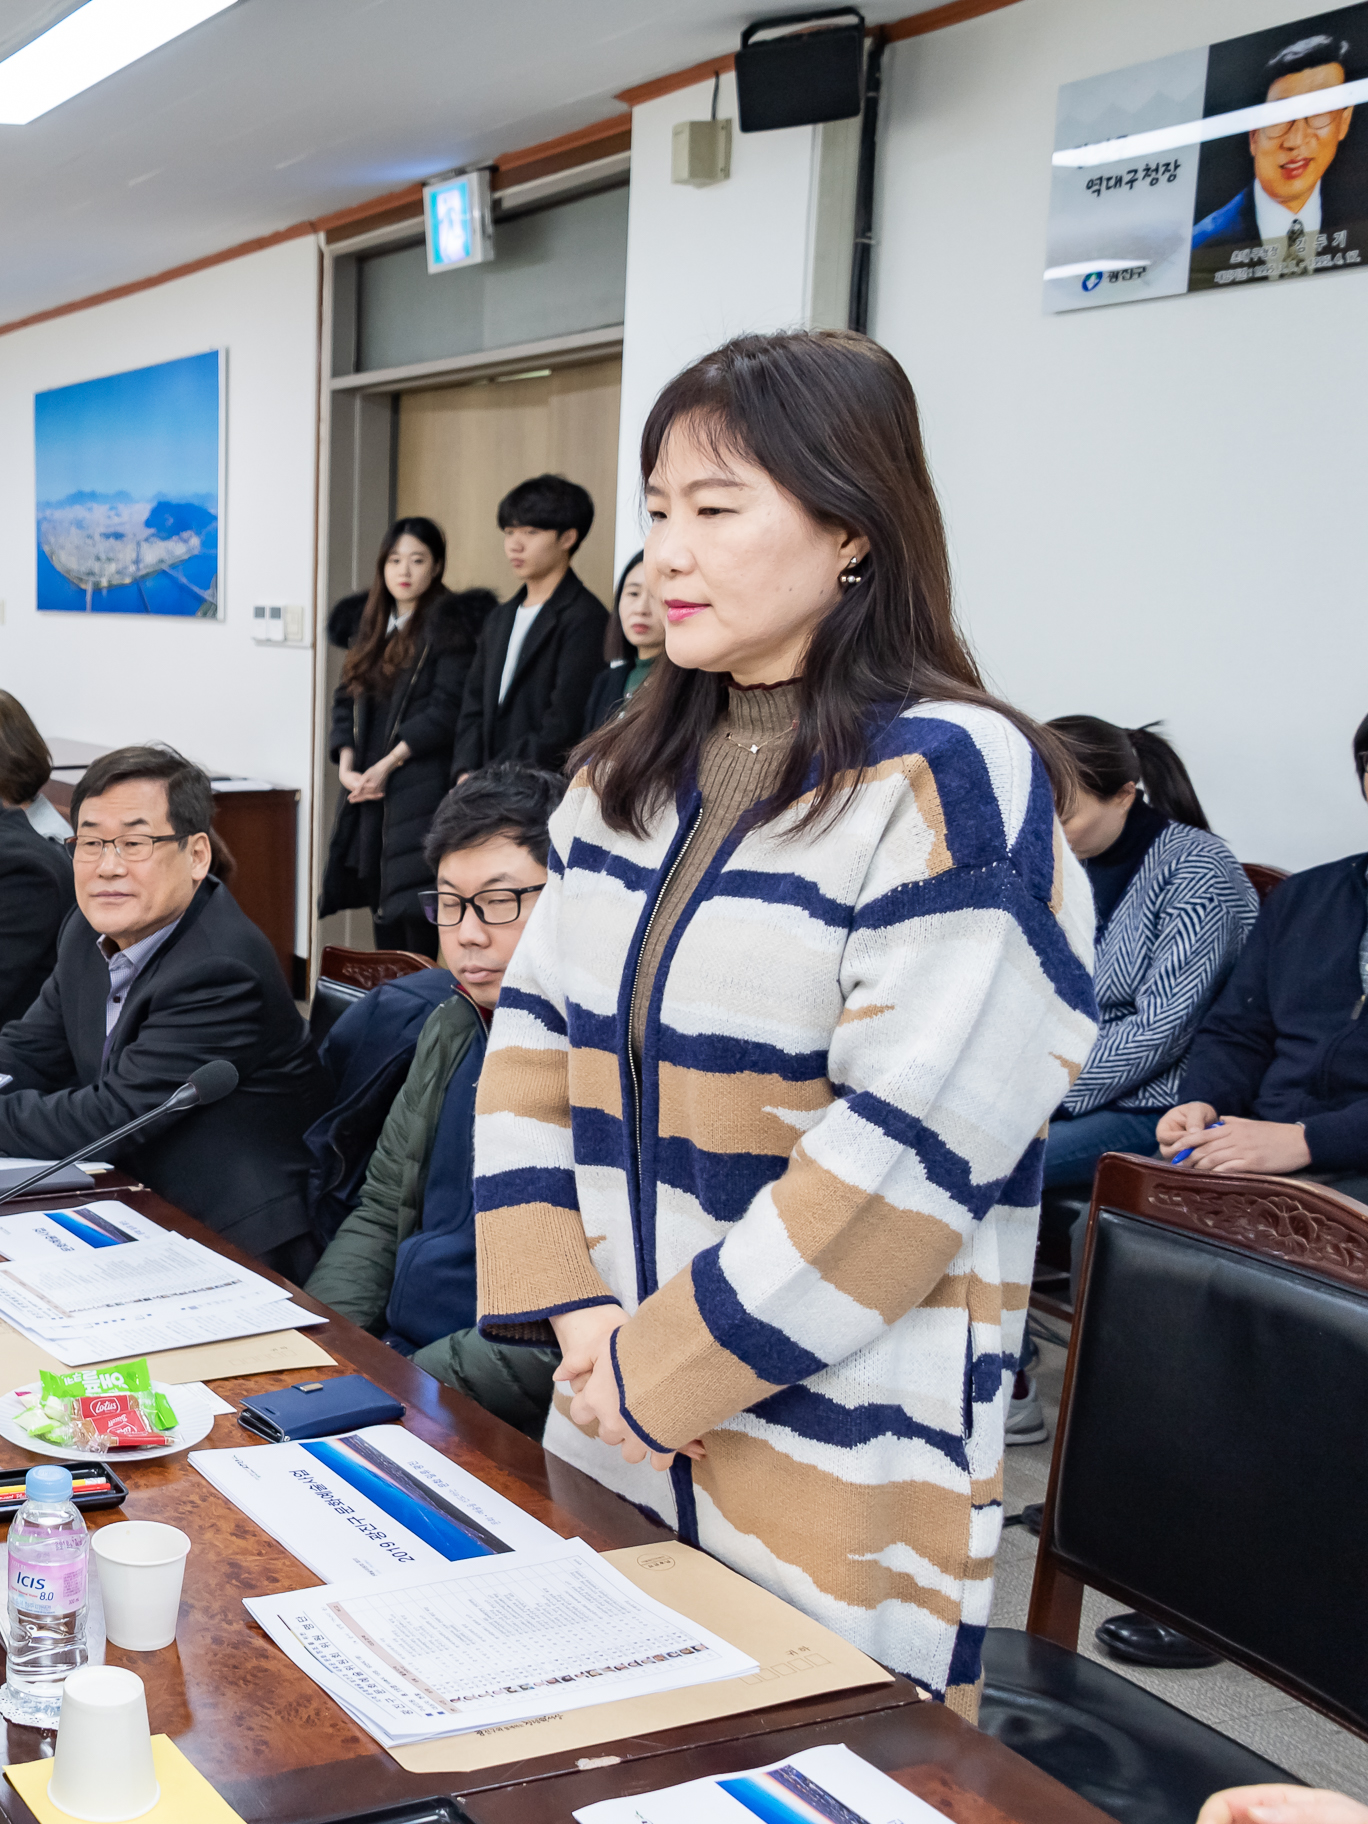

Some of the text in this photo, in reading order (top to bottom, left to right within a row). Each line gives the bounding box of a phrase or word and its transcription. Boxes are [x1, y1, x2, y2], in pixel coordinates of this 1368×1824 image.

[1085, 159, 1181, 197] 역대구청장
[95, 1401, 117, 1413] Lotus
[289, 1468, 415, 1563] 2019 광진구 문화예술사업
[16, 1571, 46, 1590] ICIS
[39, 1591, 54, 1601] 8.0
